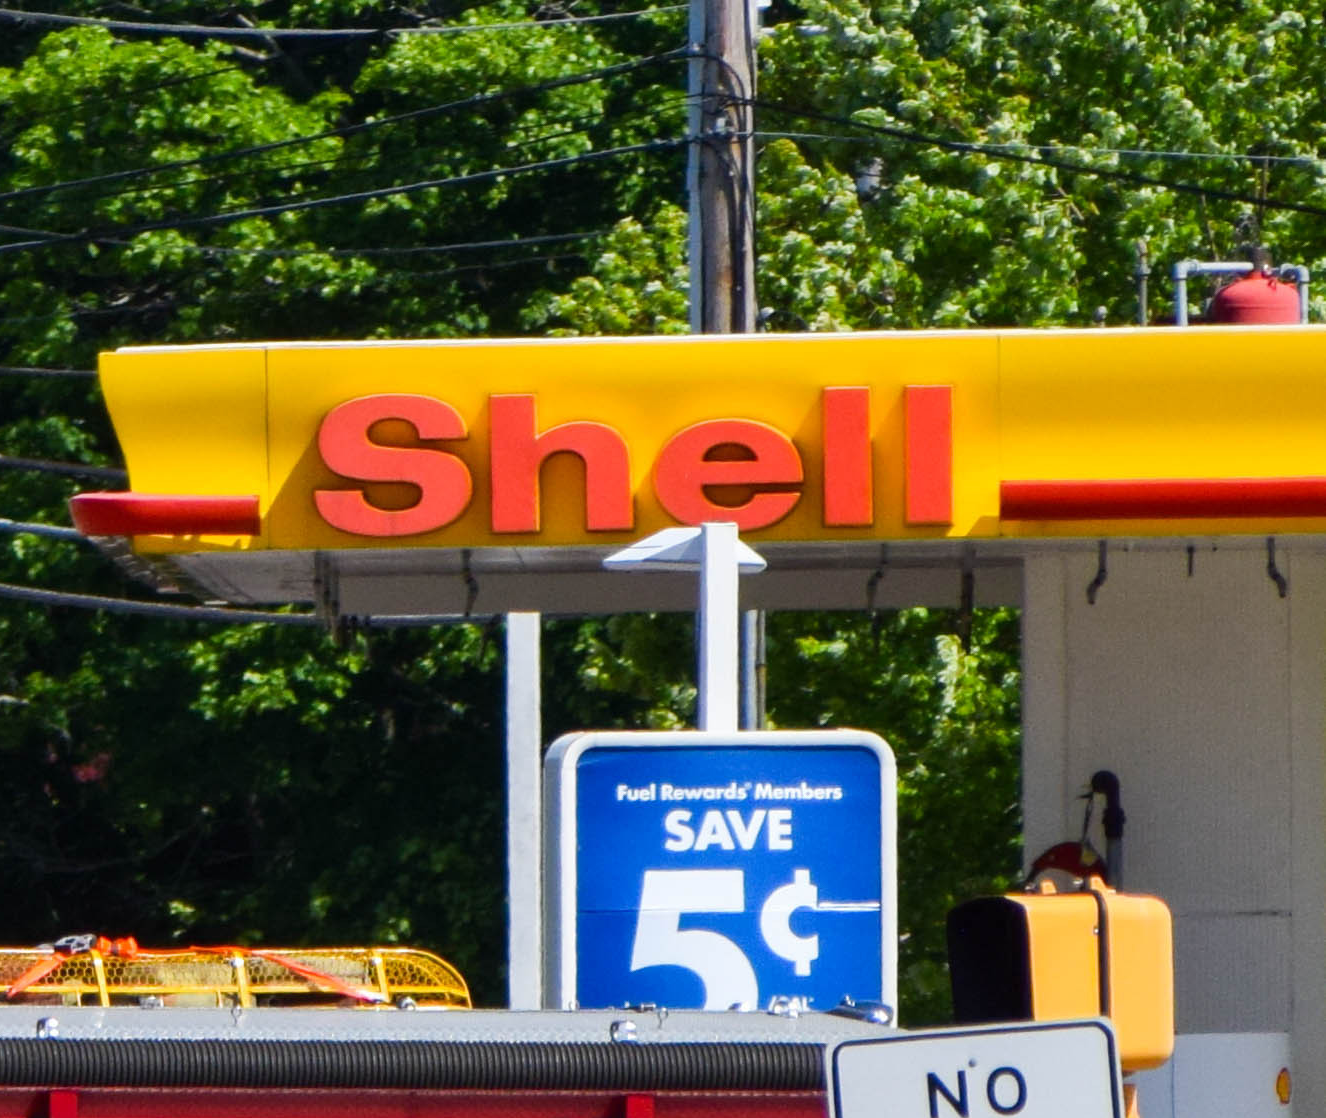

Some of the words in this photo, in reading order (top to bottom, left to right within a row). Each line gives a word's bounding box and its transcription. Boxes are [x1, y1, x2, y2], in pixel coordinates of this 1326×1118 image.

[314, 385, 952, 536] Shell
[616, 783, 656, 801] Fuel
[754, 782, 843, 801] Members
[664, 808, 793, 852] SAVE
